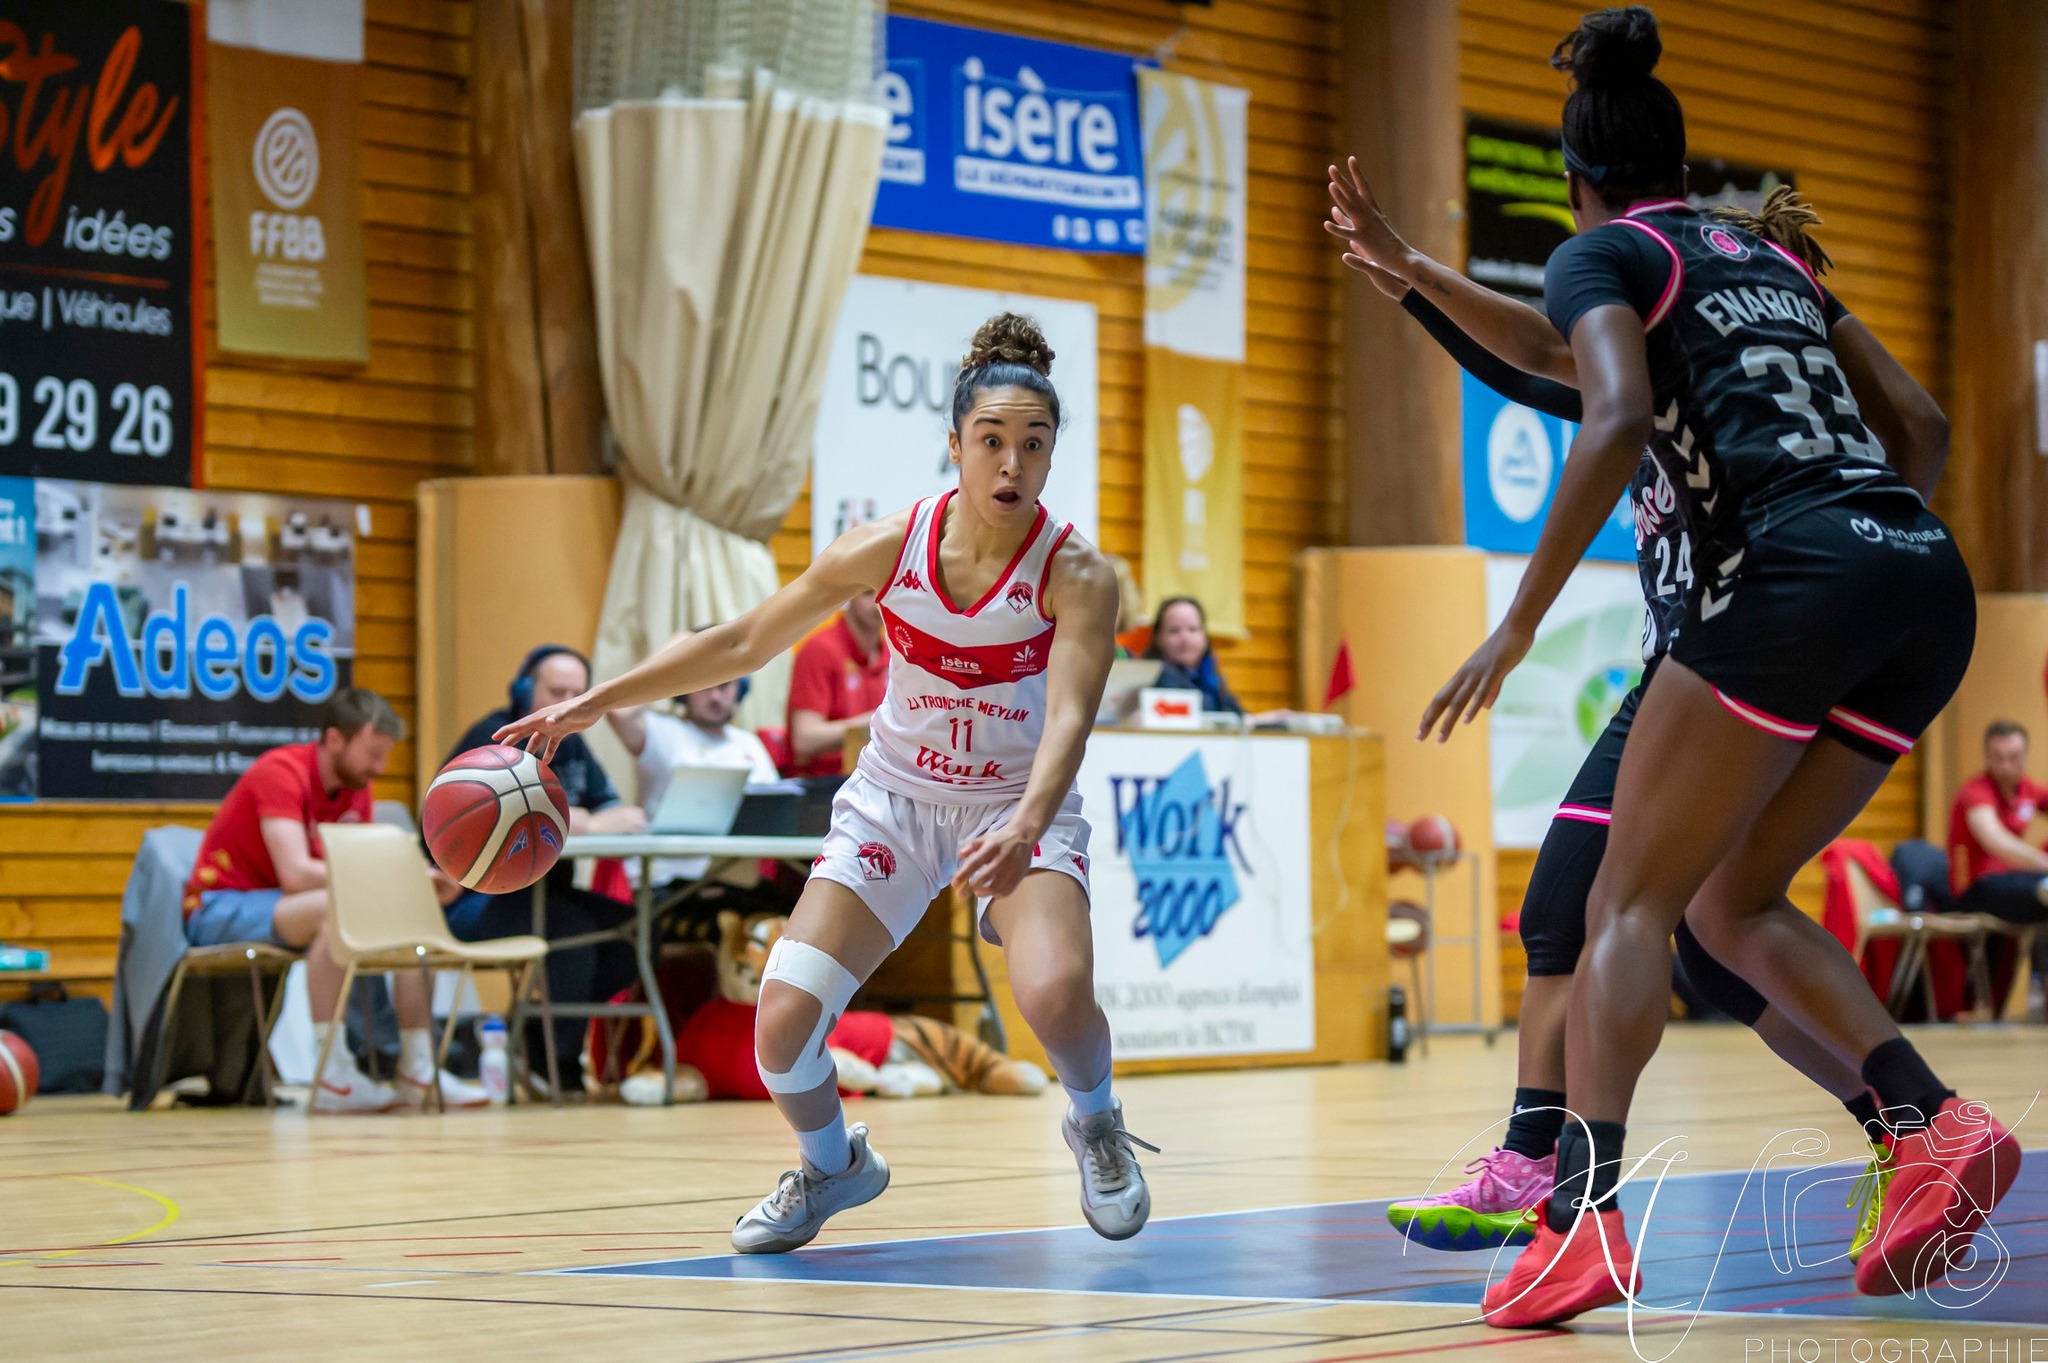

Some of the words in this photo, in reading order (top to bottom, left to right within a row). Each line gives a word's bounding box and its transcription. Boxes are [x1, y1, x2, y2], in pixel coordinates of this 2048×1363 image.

[963, 56, 1119, 172] isère
[63, 205, 175, 261] idées
[250, 210, 326, 261] FFBB
[57, 286, 173, 336] Véhicules
[32, 375, 98, 452] 29
[109, 382, 174, 458] 26
[1740, 344, 1886, 464] 33
[1654, 531, 1695, 597] 24
[55, 579, 338, 703] Adeos
[941, 656, 980, 669] isère
[907, 697, 921, 711] LA
[919, 695, 976, 711] TRONCHE
[978, 701, 1030, 723] MEYLAN
[949, 717, 973, 753] 11
[1108, 774, 1255, 877] Work
[1132, 877, 1221, 940] 2000
